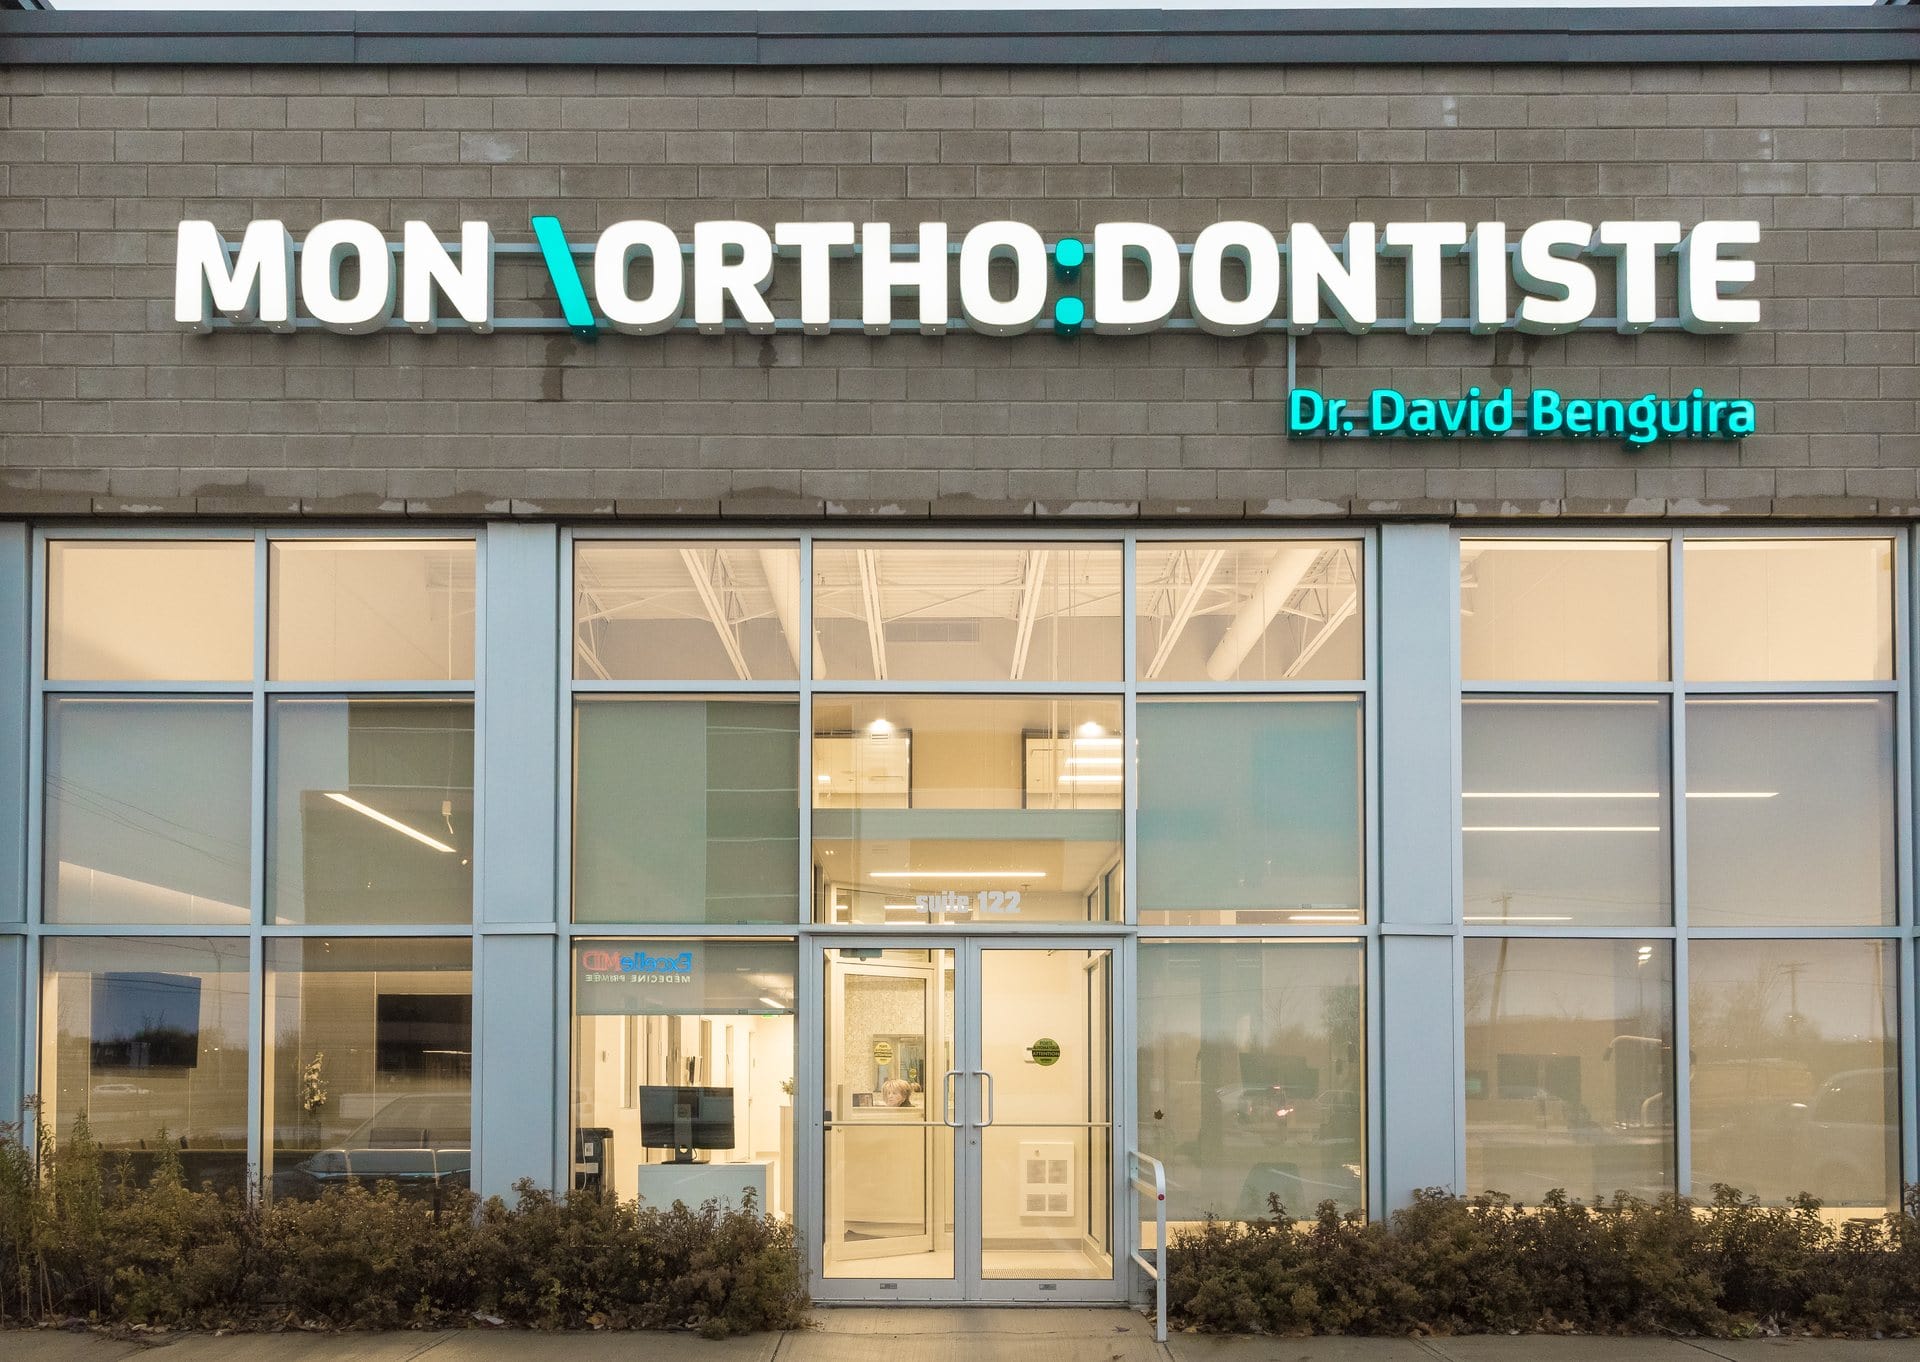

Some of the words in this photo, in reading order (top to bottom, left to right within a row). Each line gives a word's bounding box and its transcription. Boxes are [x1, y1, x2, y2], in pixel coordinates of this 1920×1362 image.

[173, 219, 496, 325] MON
[1290, 389, 1354, 432] Dr.
[1369, 386, 1513, 432] David
[1532, 387, 1756, 443] Benguira
[915, 890, 969, 913] suite
[977, 890, 1021, 913] 122
